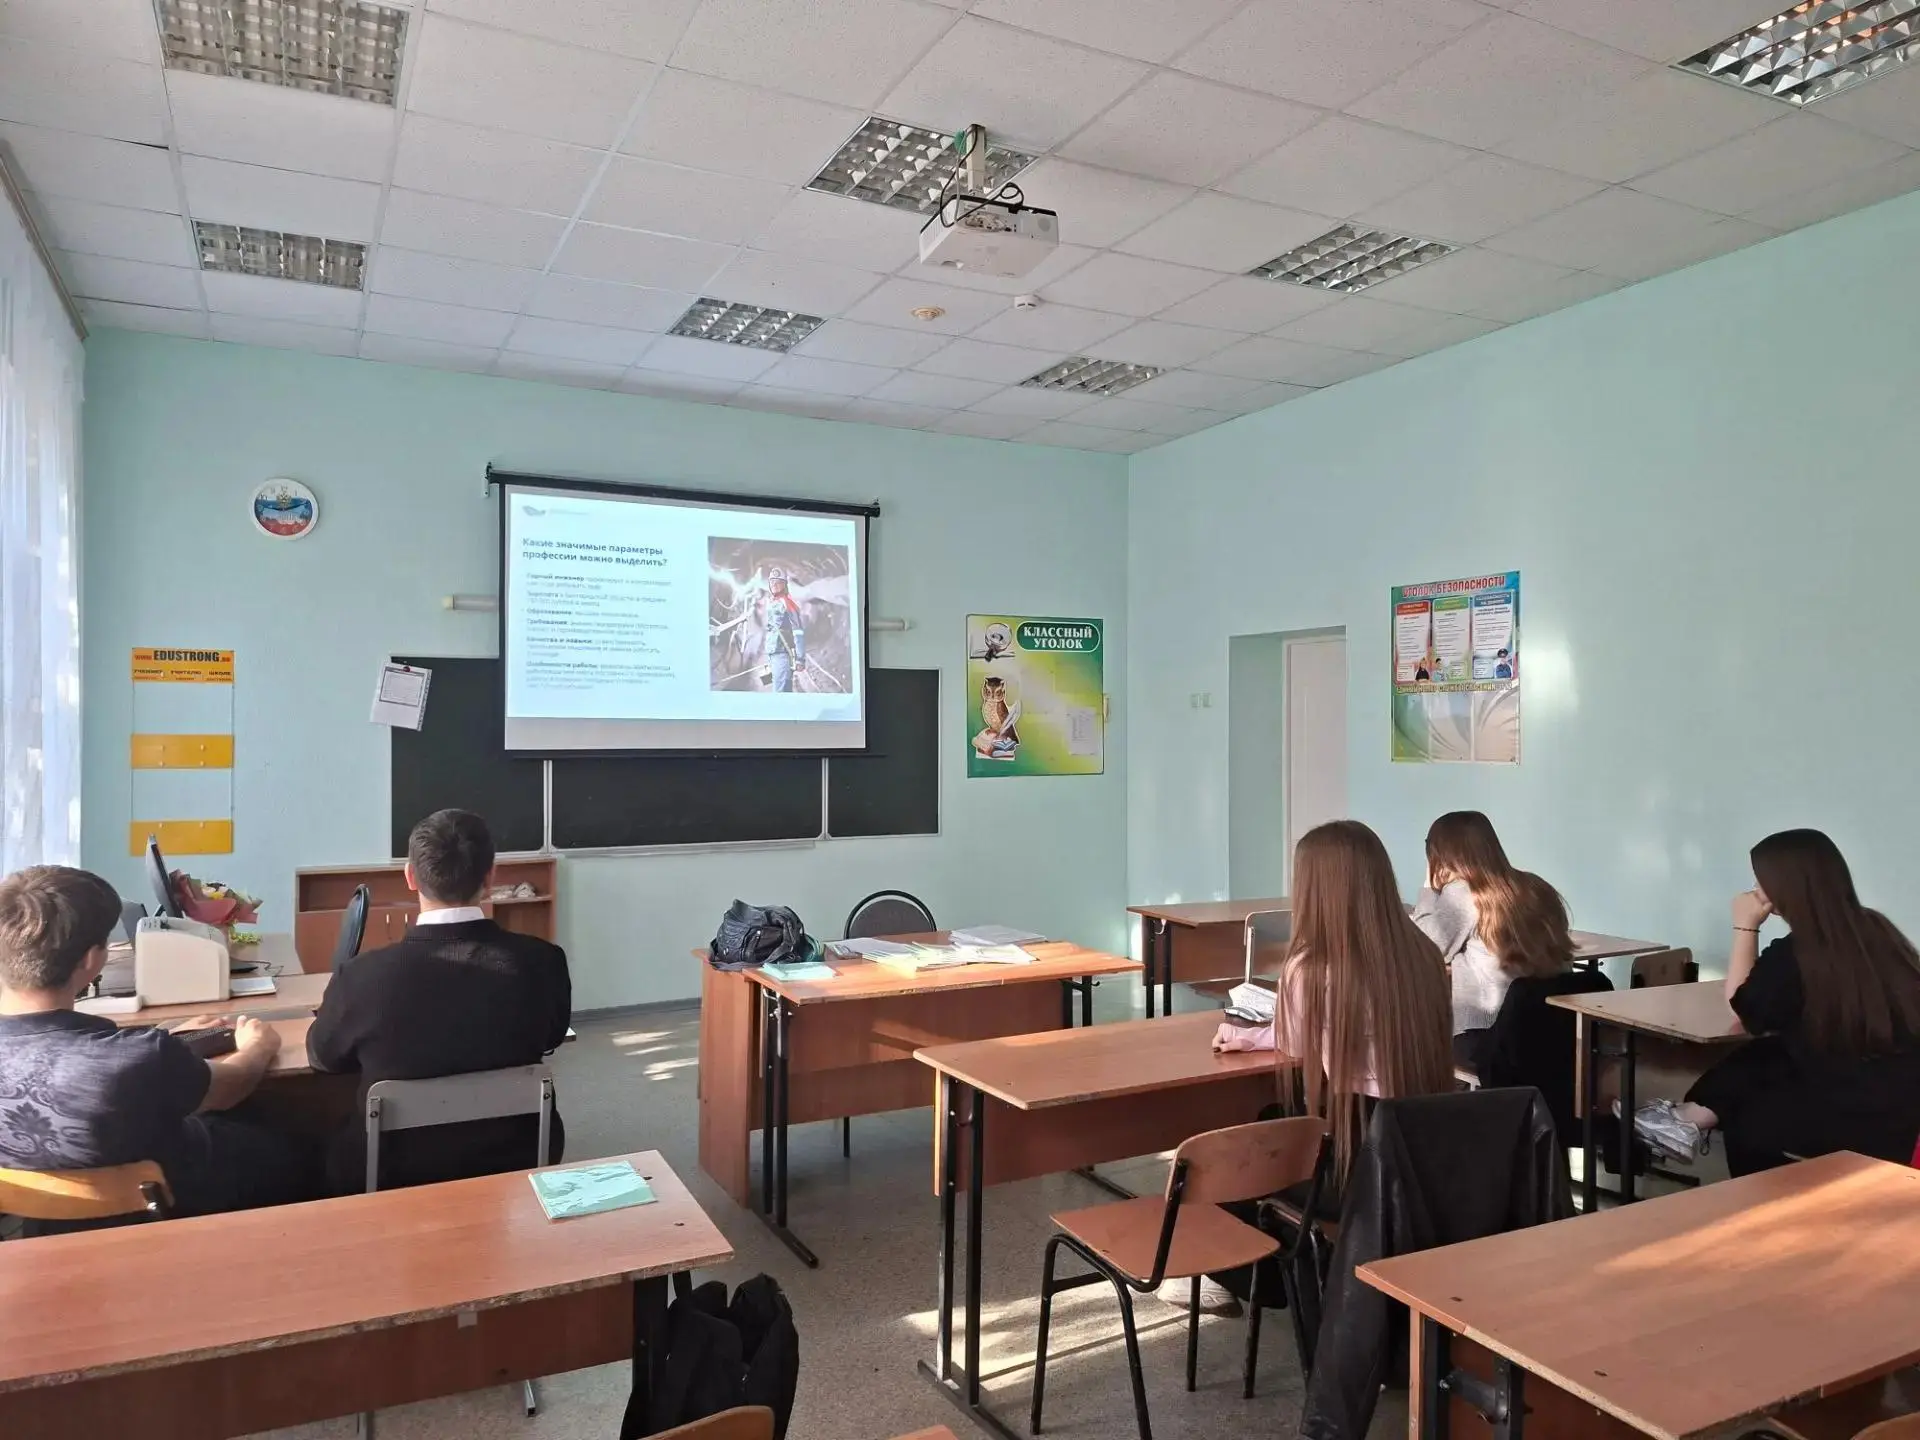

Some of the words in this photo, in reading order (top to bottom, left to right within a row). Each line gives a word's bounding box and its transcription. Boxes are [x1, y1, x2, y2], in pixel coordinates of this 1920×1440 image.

[522, 538, 553, 548] Какие
[556, 541, 606, 551] значимые
[609, 545, 663, 556] параметры
[522, 551, 577, 561] профессии
[615, 557, 668, 567] выделить?
[1437, 575, 1505, 593] БЕЗОПАСНОСТИ
[1023, 626, 1093, 638] КЛАССНЫЙ
[1034, 638, 1083, 649] УГОЛОК
[153, 650, 220, 662] EDUSTRONG
